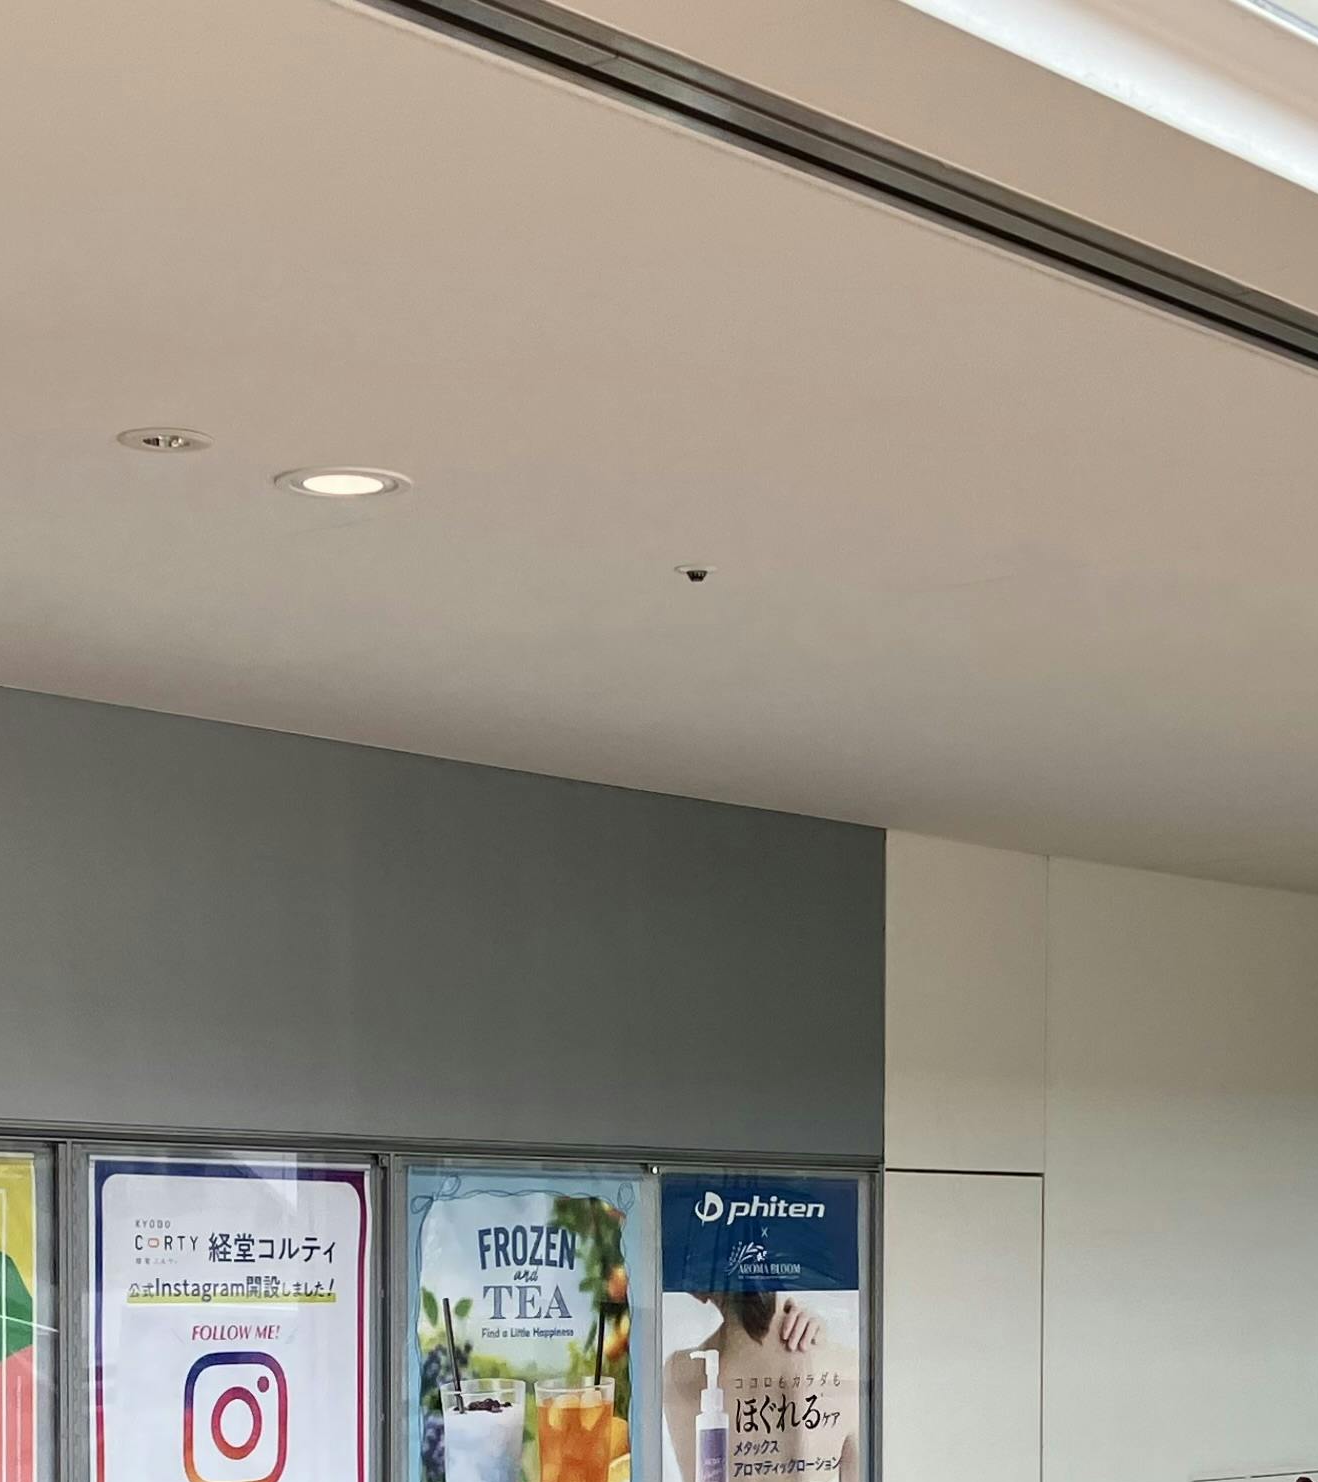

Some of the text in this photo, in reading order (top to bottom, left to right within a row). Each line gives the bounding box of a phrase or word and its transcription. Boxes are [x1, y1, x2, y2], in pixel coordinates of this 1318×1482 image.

[727, 1195, 825, 1225] phiten
[208, 1232, 336, 1264] 経堂コルティ
[477, 1225, 577, 1271] FROZEN
[738, 1263, 801, 1274] AROMA BLOOM
[483, 1285, 573, 1320] TEA
[191, 1325, 281, 1341] FOLLOW ME!
[482, 1328, 499, 1338] Find
[510, 1327, 531, 1338] Little
[533, 1328, 574, 1339] Happiness
[735, 1372, 841, 1389] ココロもカラダも
[734, 1440, 779, 1456] メタックス
[734, 1457, 840, 1477] アロマティックローション
